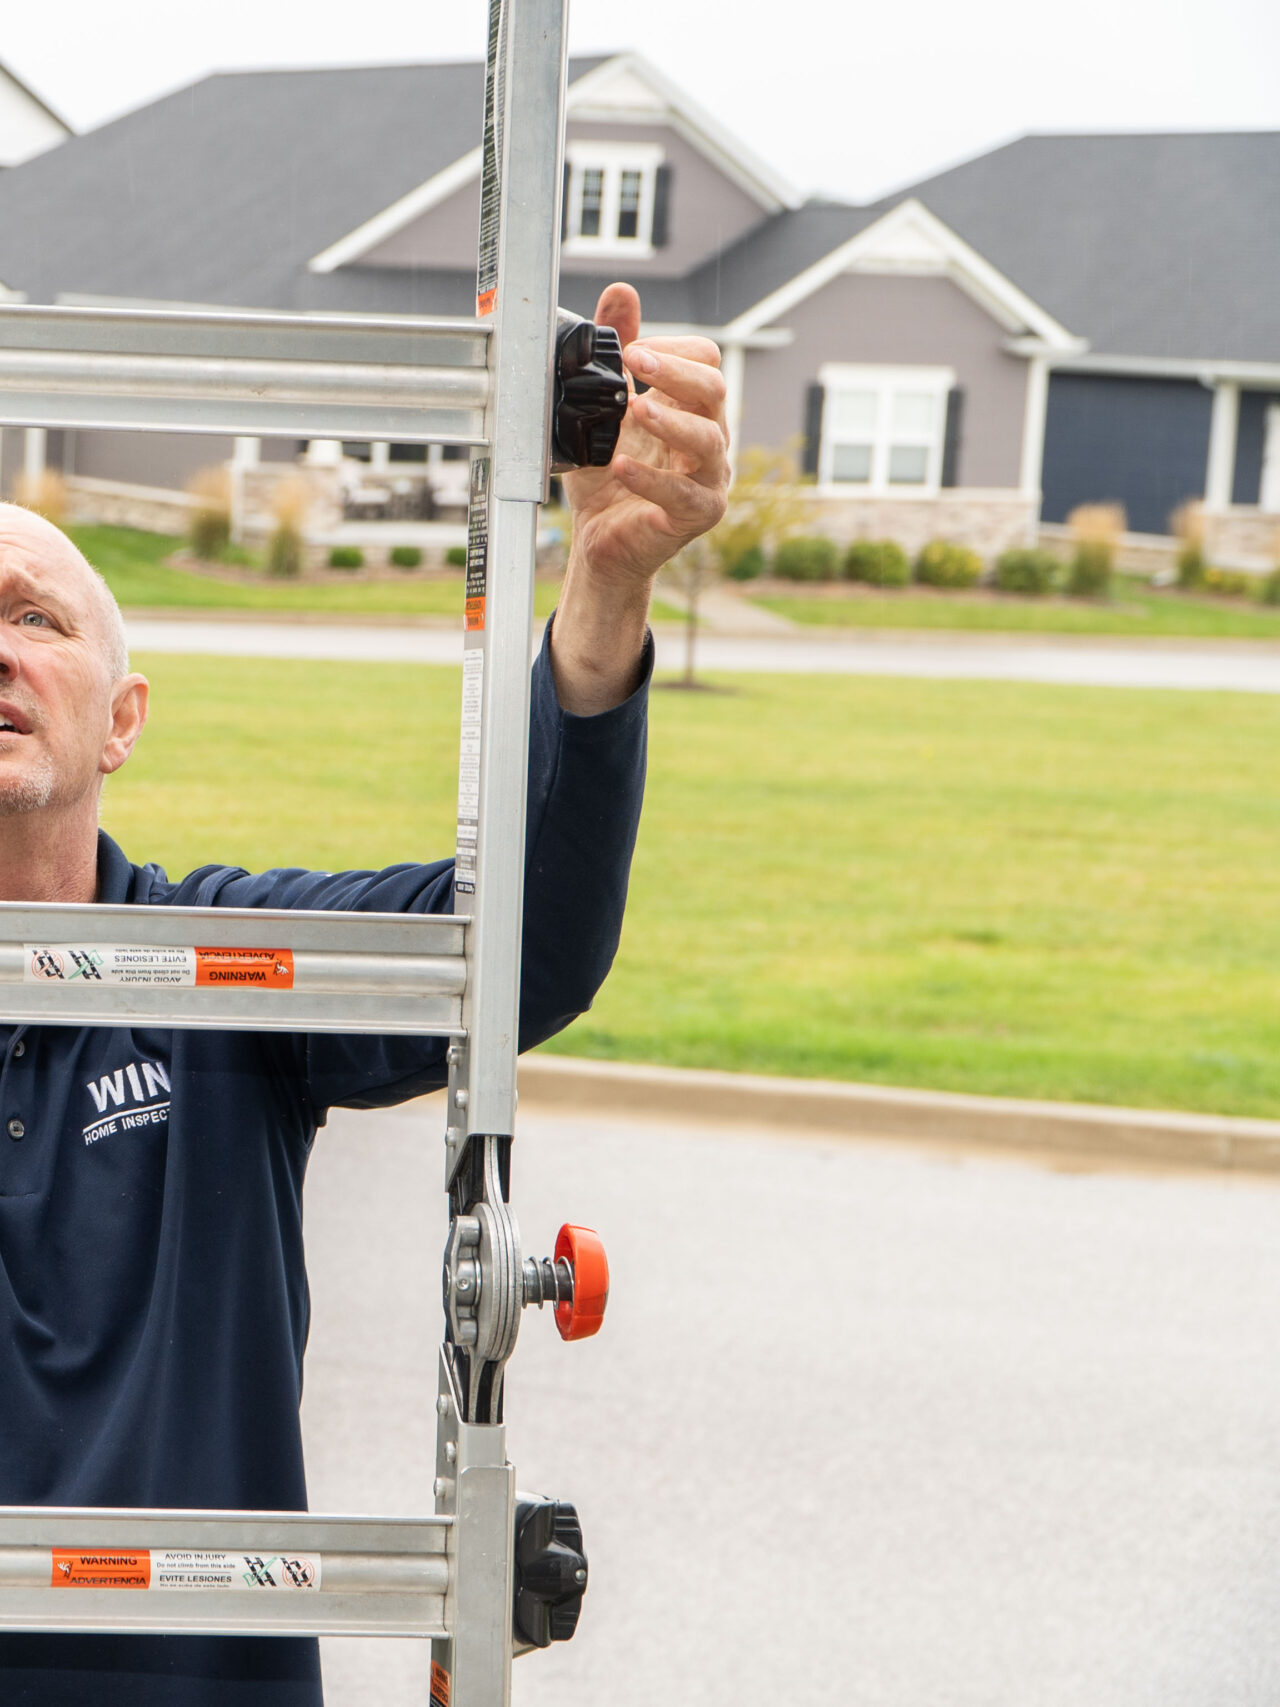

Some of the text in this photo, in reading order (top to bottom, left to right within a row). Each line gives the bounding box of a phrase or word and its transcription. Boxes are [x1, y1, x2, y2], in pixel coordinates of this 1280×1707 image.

[199, 951, 276, 960] ADVERTENCIA
[209, 971, 267, 981] WARNING
[86, 1061, 172, 1113] WIN
[84, 1120, 118, 1146] HOME
[80, 1556, 138, 1566] WARNING
[70, 1576, 146, 1585] ADVERTENCIA
[187, 1575, 232, 1583] LESIONES
